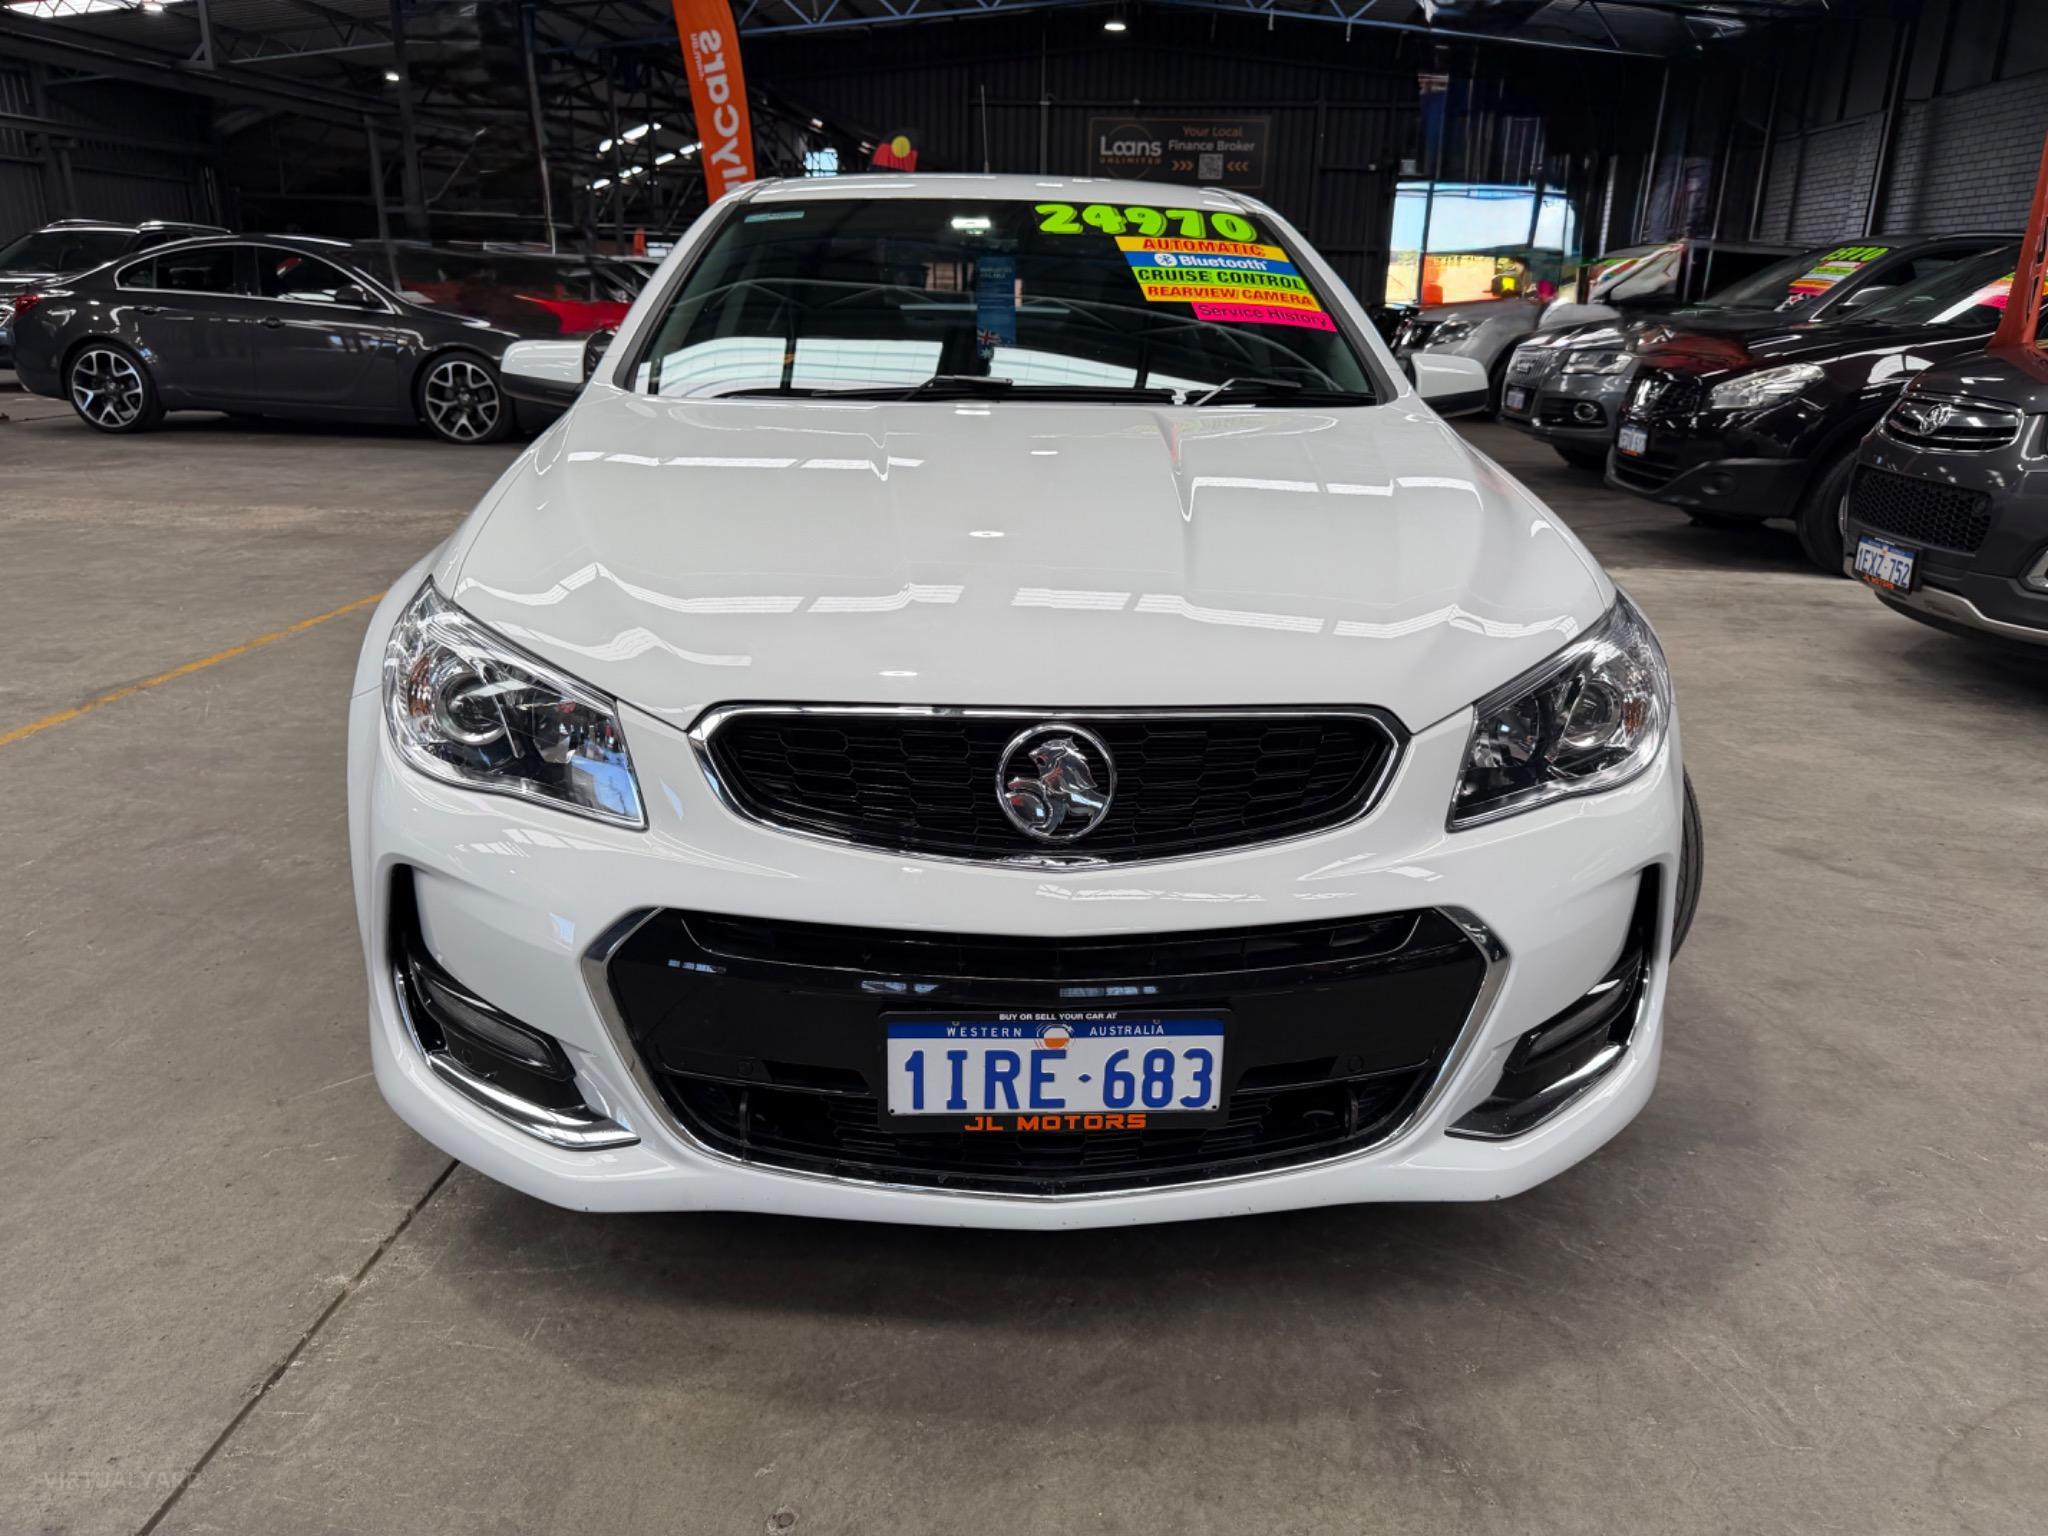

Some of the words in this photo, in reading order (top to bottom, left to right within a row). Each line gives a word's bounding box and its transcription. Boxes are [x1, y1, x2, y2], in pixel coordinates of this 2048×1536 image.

[1183, 126, 1210, 137] Your
[1212, 127, 1243, 137] Local
[1100, 136, 1162, 157] Loans
[1168, 139, 1215, 151] Finance
[1217, 141, 1256, 152] Broker
[1034, 203, 1257, 242] 24970
[1142, 238, 1265, 257] AUTOMATIC
[1178, 254, 1267, 272] Bluetooth
[1138, 268, 1210, 283] CRUISE
[1217, 271, 1304, 290] CONTROL
[1147, 285, 1235, 300] REARVIEW
[1242, 289, 1312, 306] CAMERA
[1199, 304, 1264, 319] Service
[1267, 310, 1327, 328] History
[999, 1013, 1018, 1021] BUY
[1060, 1012, 1084, 1020] YOUR
[946, 1027, 1022, 1038] WESTERN
[1089, 1025, 1165, 1036] AUSTRALIA
[965, 1116, 1004, 1131] JL
[1017, 1114, 1147, 1131] MOTORS
